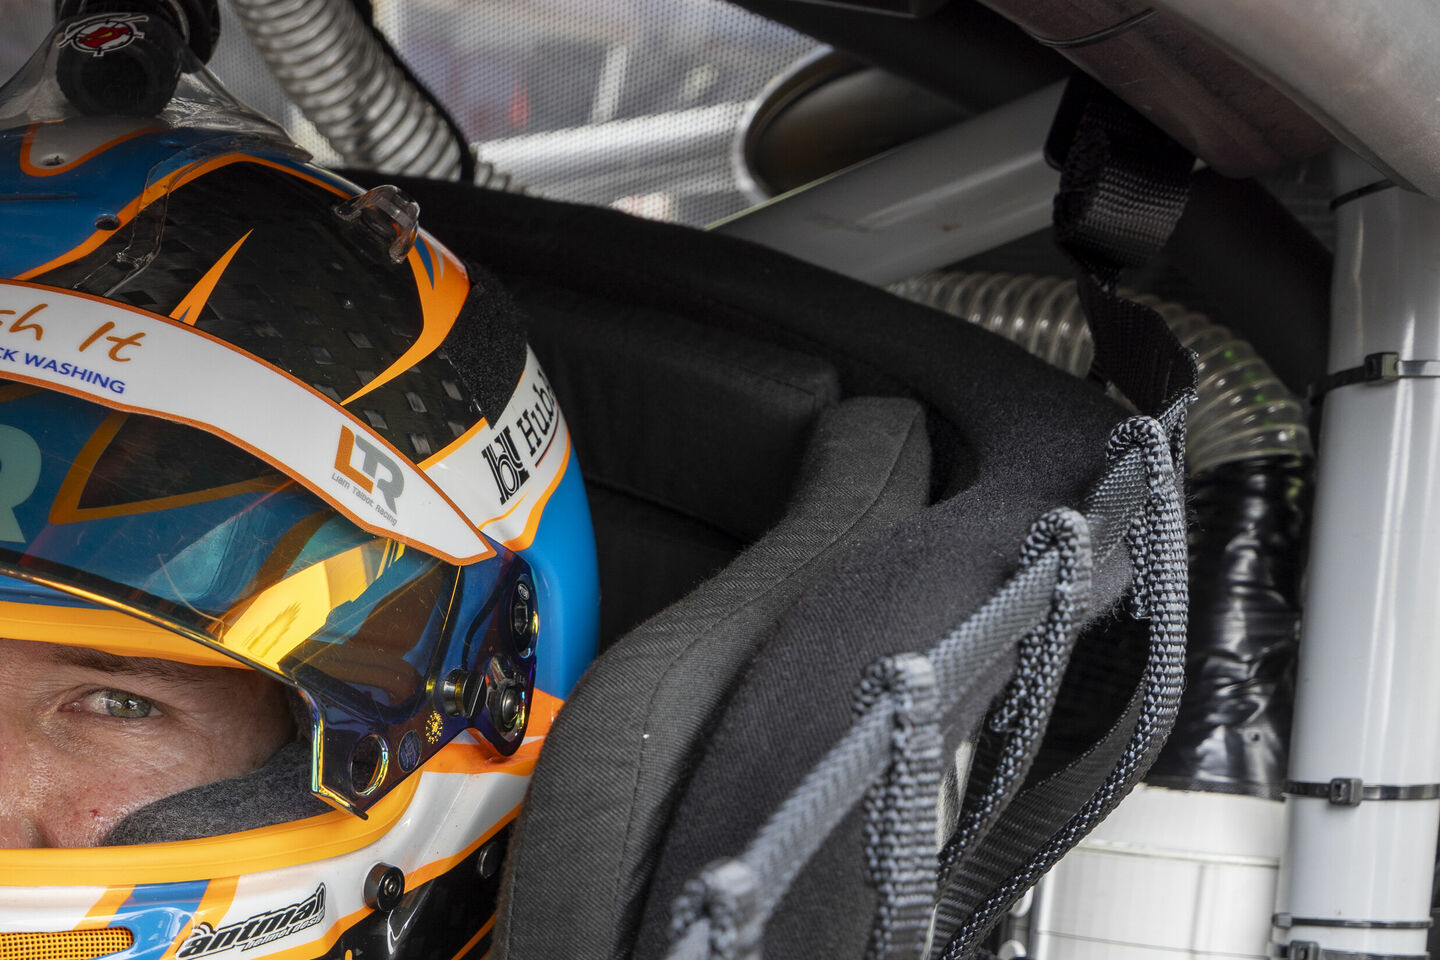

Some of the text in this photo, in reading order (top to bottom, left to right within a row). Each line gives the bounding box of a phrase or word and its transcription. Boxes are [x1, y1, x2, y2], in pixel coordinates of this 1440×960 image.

[79, 321, 146, 362] It
[24, 353, 126, 395] WASHING
[331, 472, 352, 491] Liam
[334, 424, 405, 515] LTR
